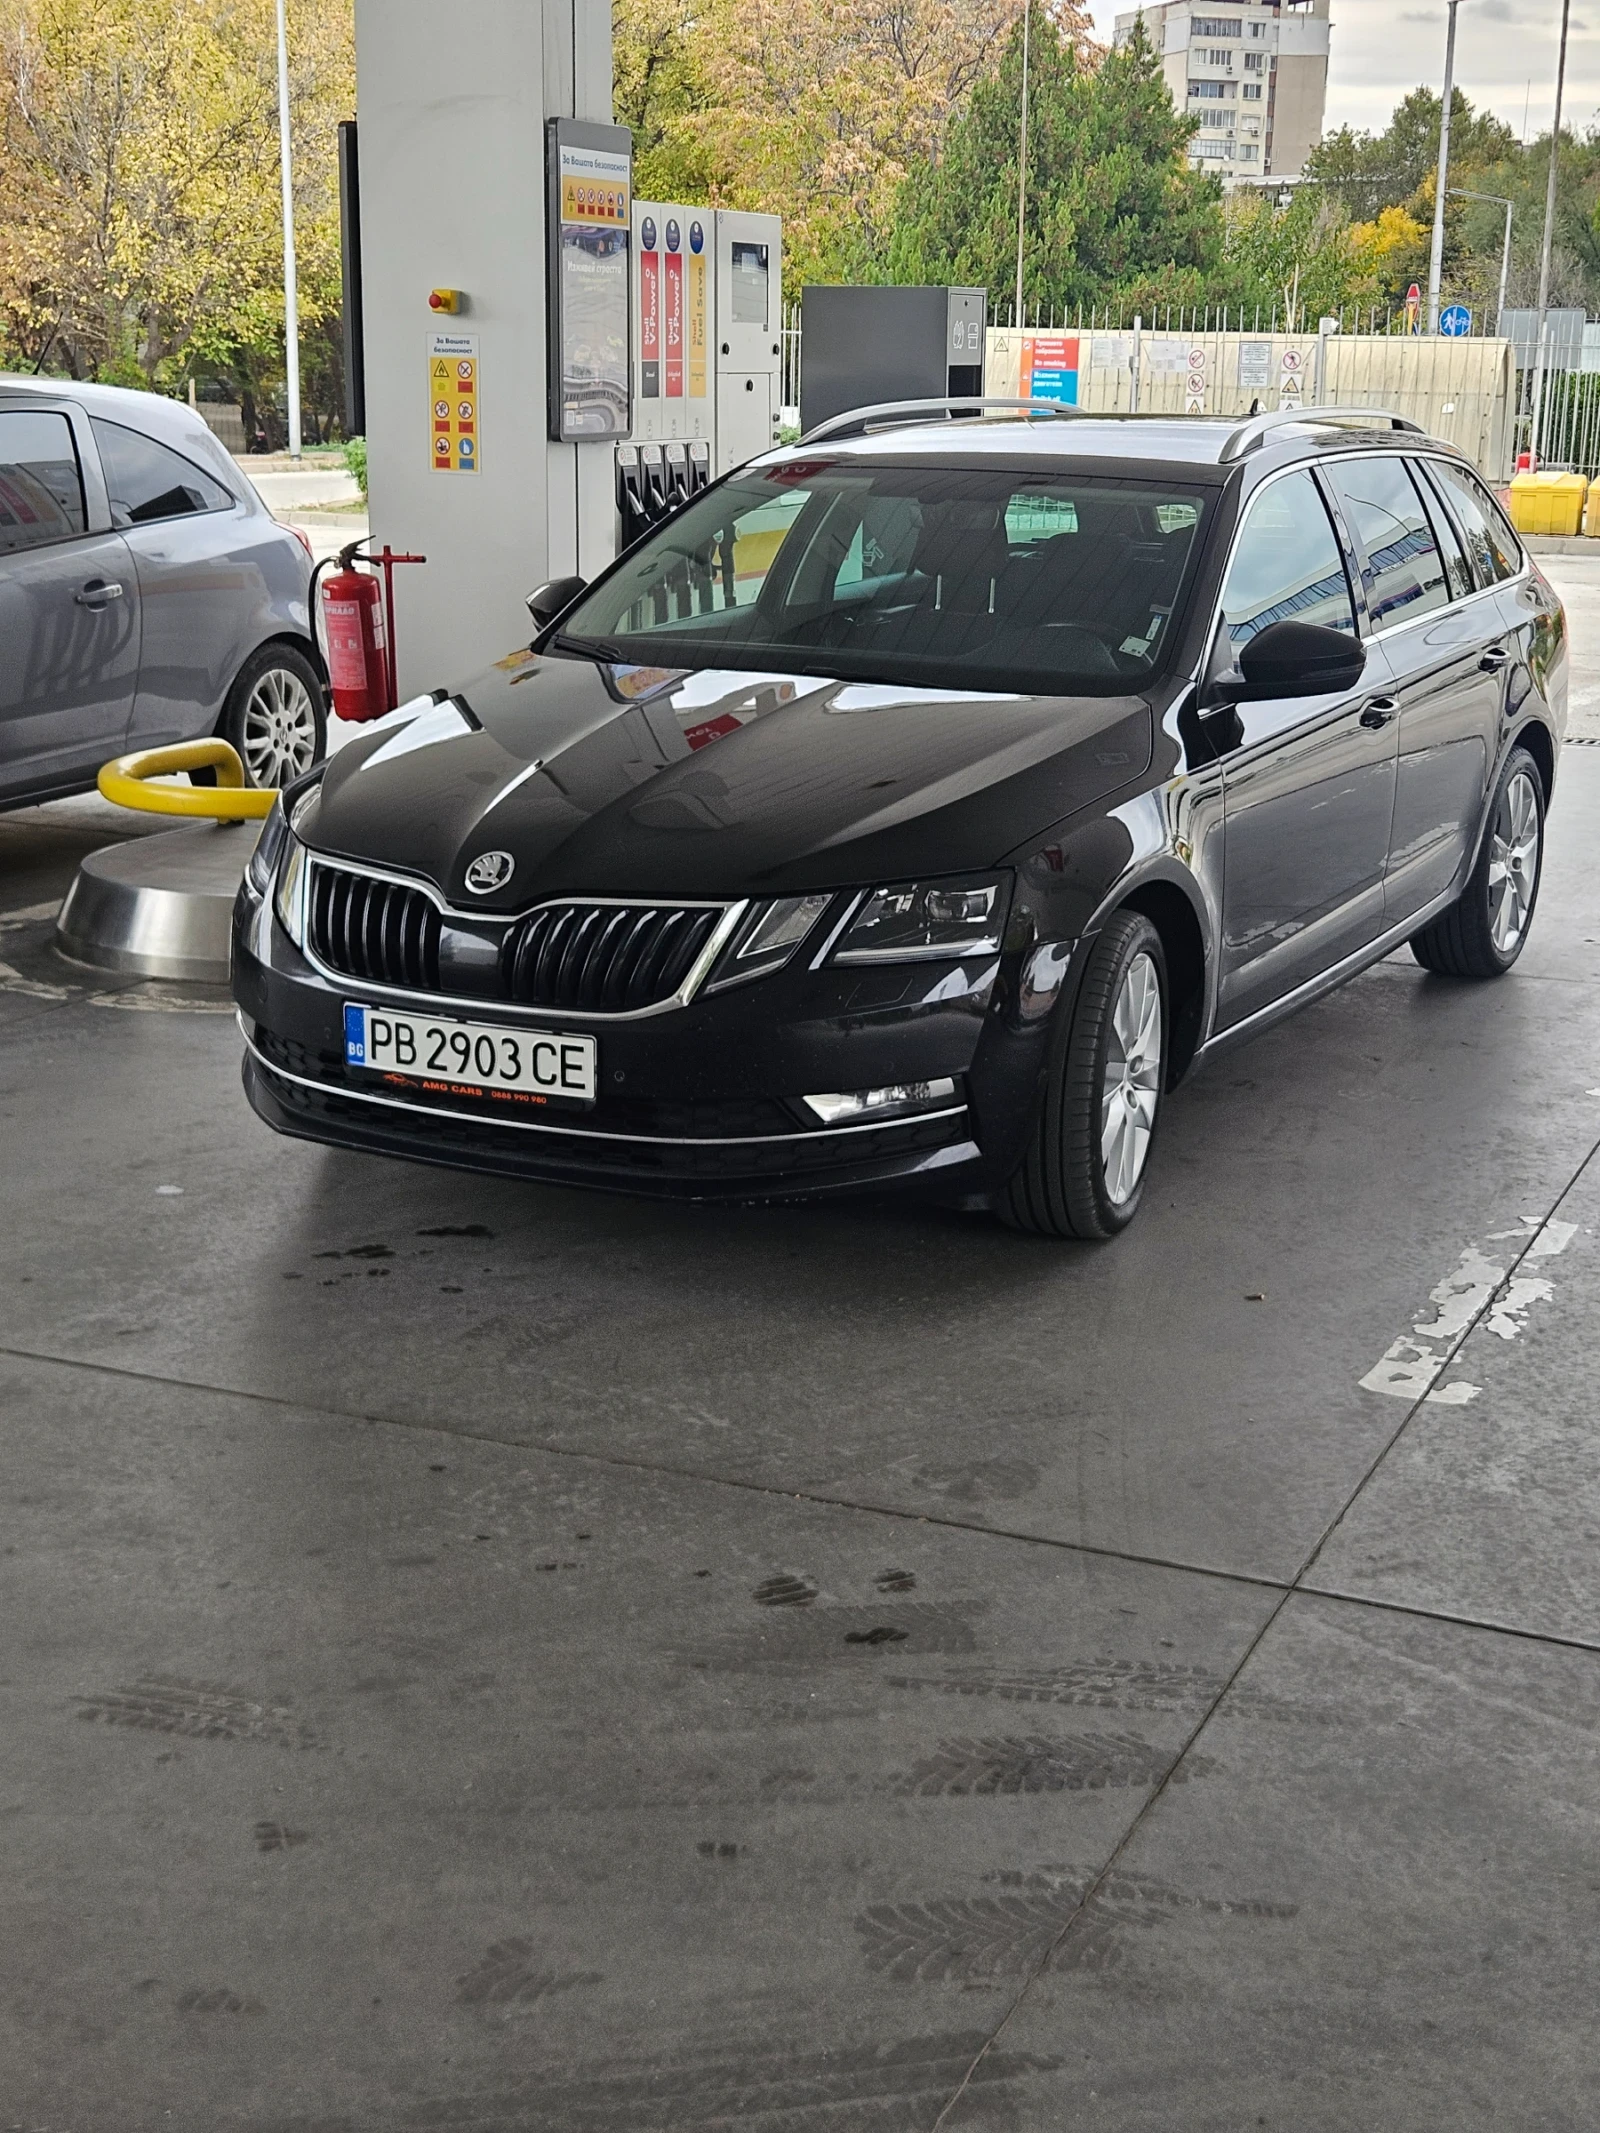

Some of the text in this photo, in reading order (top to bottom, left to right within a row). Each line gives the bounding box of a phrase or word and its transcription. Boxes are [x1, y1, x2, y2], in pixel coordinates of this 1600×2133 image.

[562, 154, 570, 164] За
[571, 156, 593, 168] Вашата
[434, 346, 472, 354] безопасност
[347, 1042, 364, 1057] BG
[370, 1017, 586, 1090] PB 2903 CE
[422, 1080, 448, 1091] AMG
[451, 1085, 483, 1097] CARS
